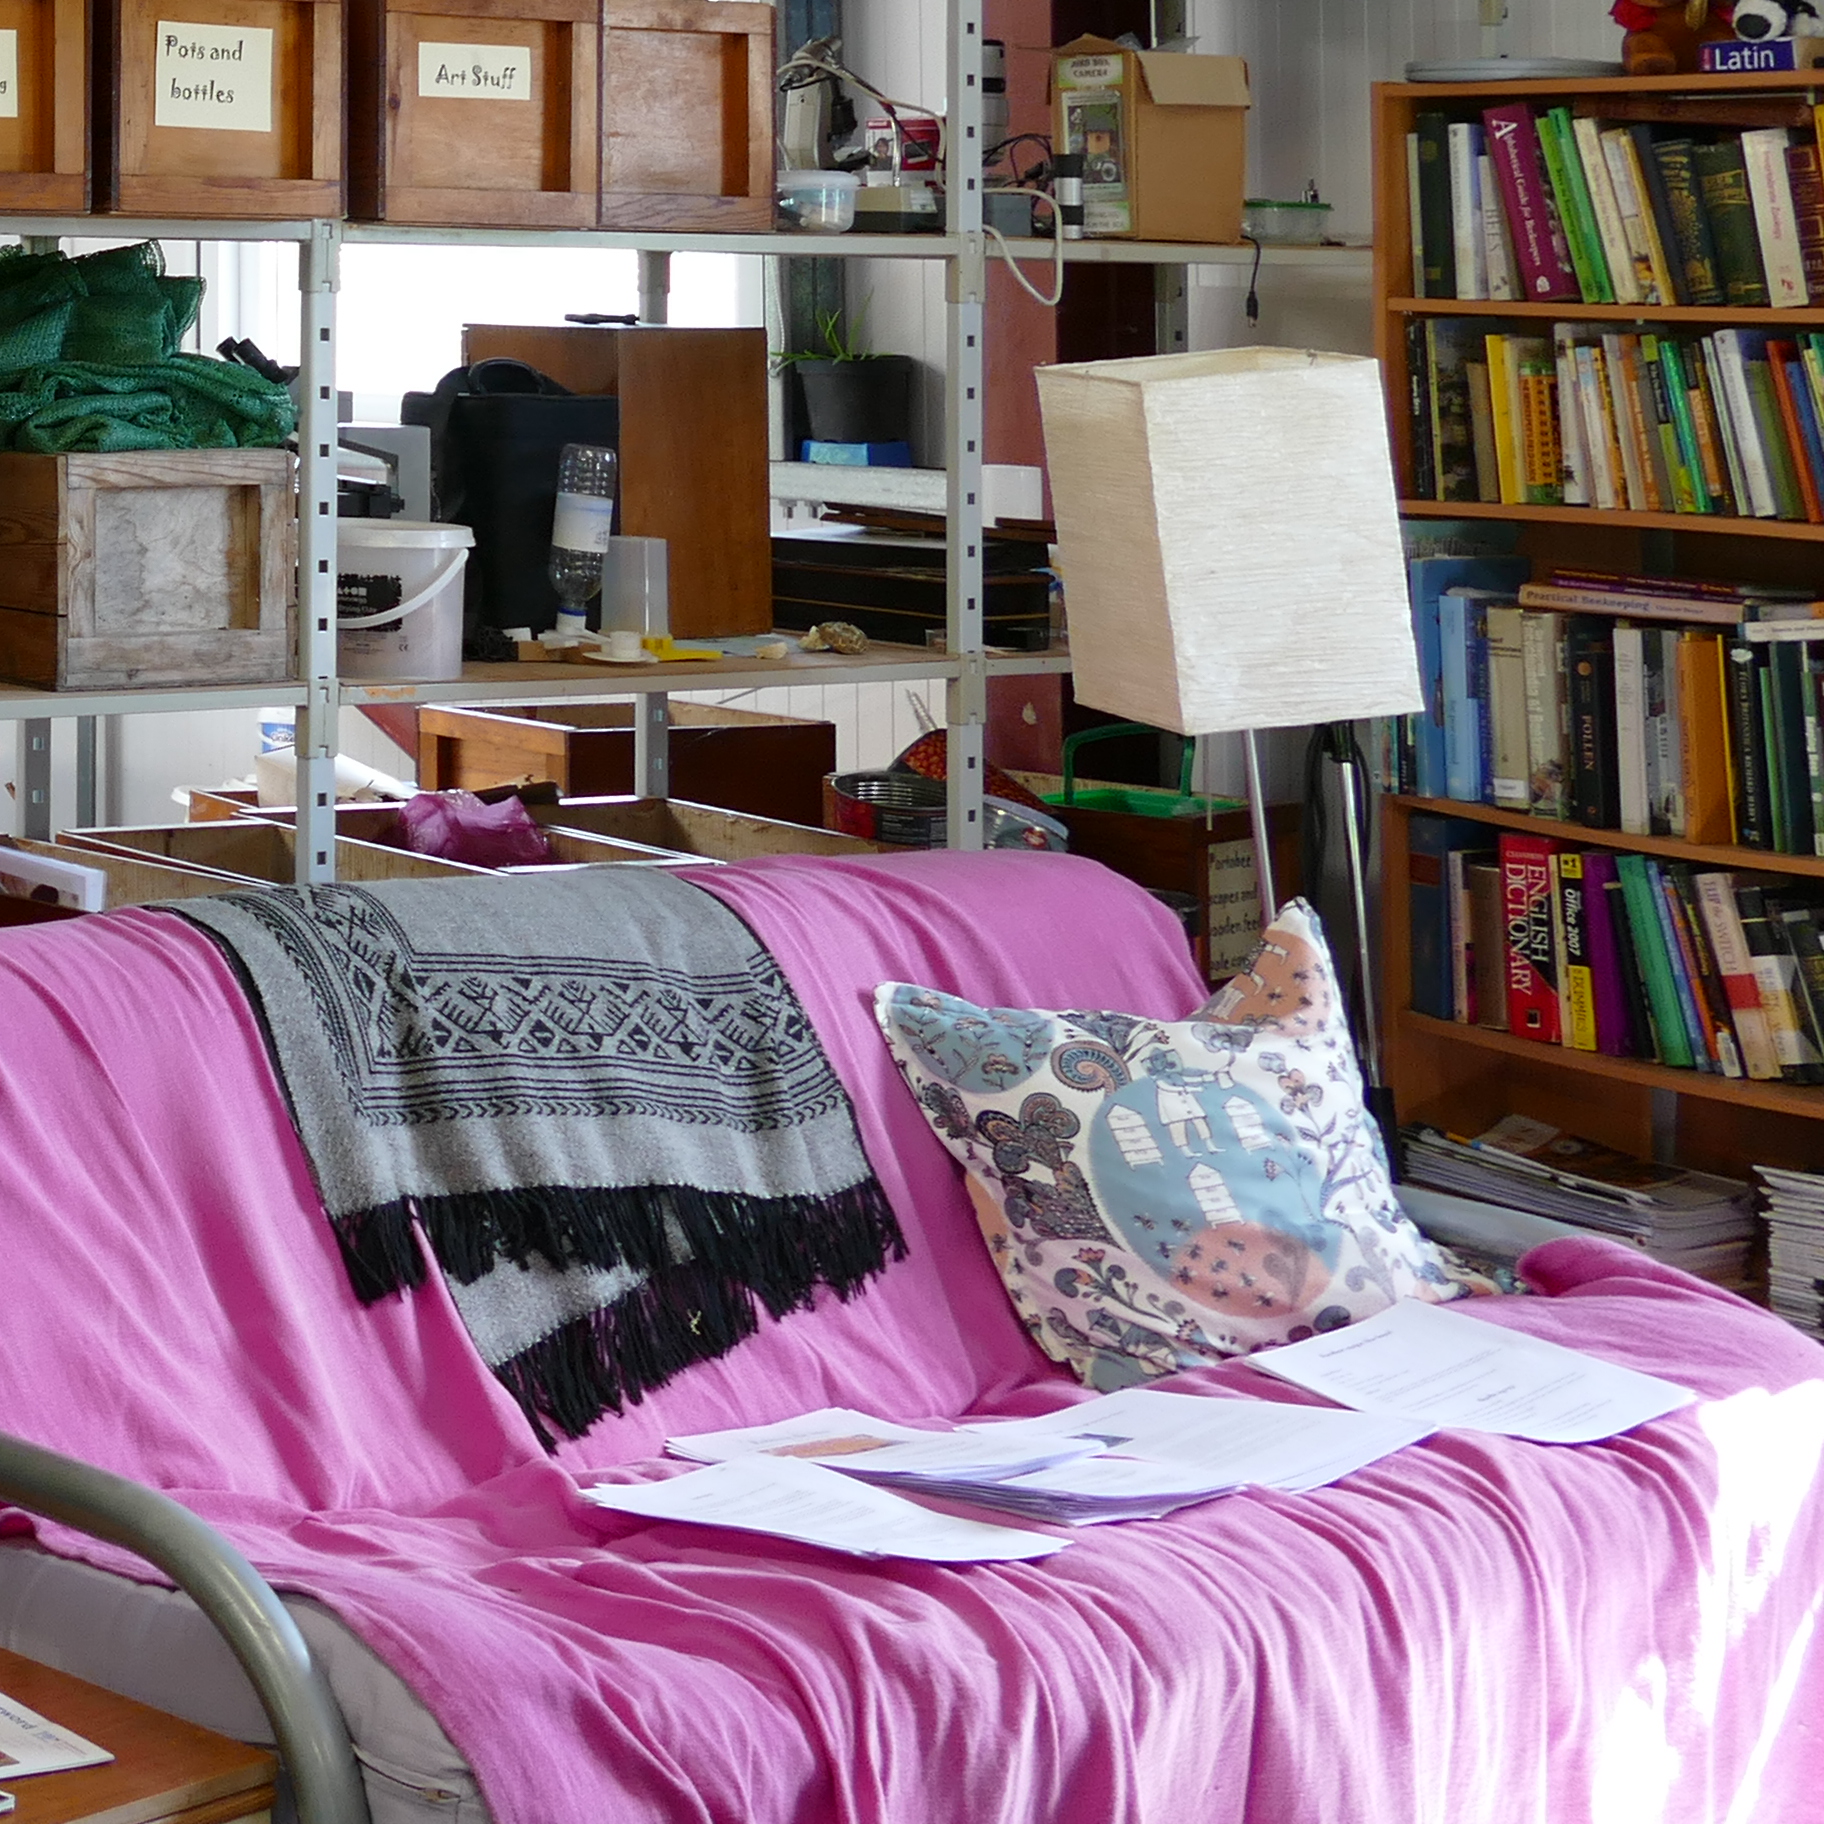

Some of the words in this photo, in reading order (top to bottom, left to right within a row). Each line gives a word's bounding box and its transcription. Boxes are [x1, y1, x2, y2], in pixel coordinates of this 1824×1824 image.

[165, 35, 206, 60] Pots
[210, 40, 243, 61] and
[1715, 47, 1774, 70] Latin
[171, 78, 234, 104] bottles
[435, 64, 467, 86] Art
[472, 65, 516, 90] Stuff
[1515, 179, 1529, 205] Guide
[1518, 206, 1532, 218] for
[1485, 209, 1501, 252] BEES
[1526, 591, 1578, 602] Practical
[1581, 715, 1594, 771] POLLEN
[1528, 865, 1549, 963] ENGLISH
[1564, 888, 1579, 924] Office
[1505, 863, 1532, 995] DICTIONARY
[1567, 925, 1581, 957] 2007
[1716, 922, 1737, 972] SWITCH
